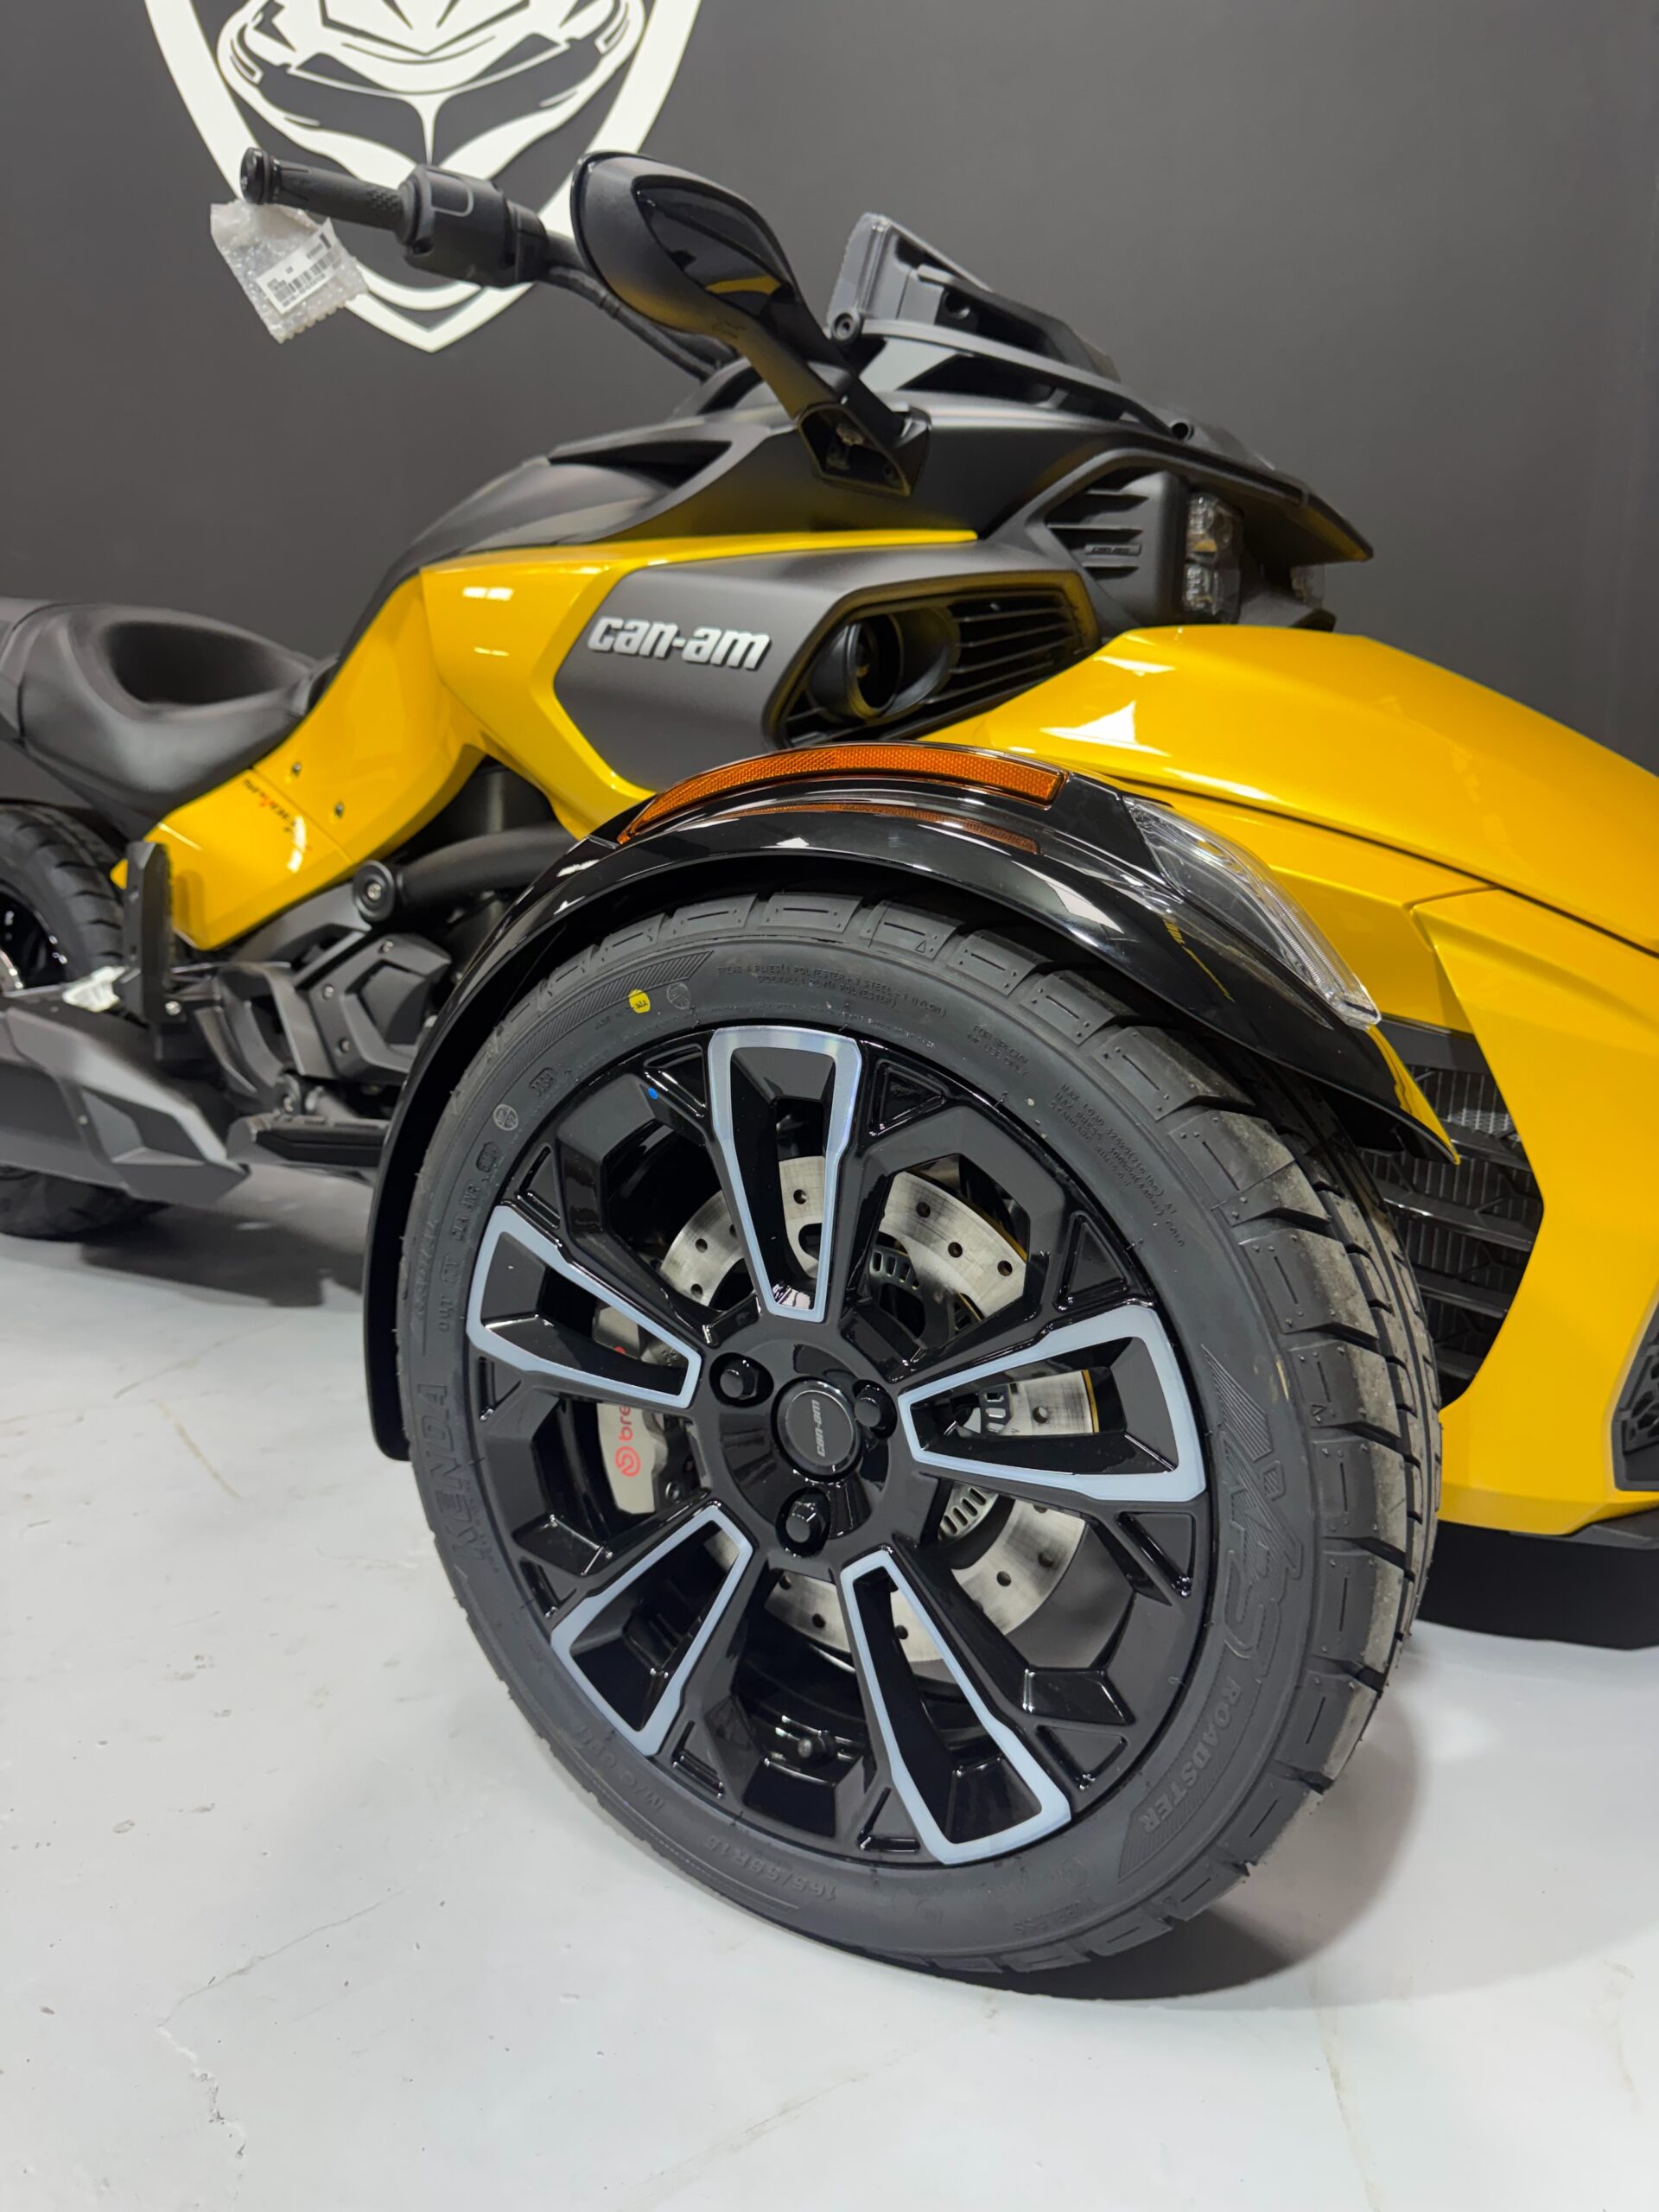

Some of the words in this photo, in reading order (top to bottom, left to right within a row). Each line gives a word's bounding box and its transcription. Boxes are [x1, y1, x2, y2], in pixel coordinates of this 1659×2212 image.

[588, 616, 772, 671] can-am
[810, 1398, 826, 1459] can-am
[1138, 1675, 1242, 1834] ROADSTER
